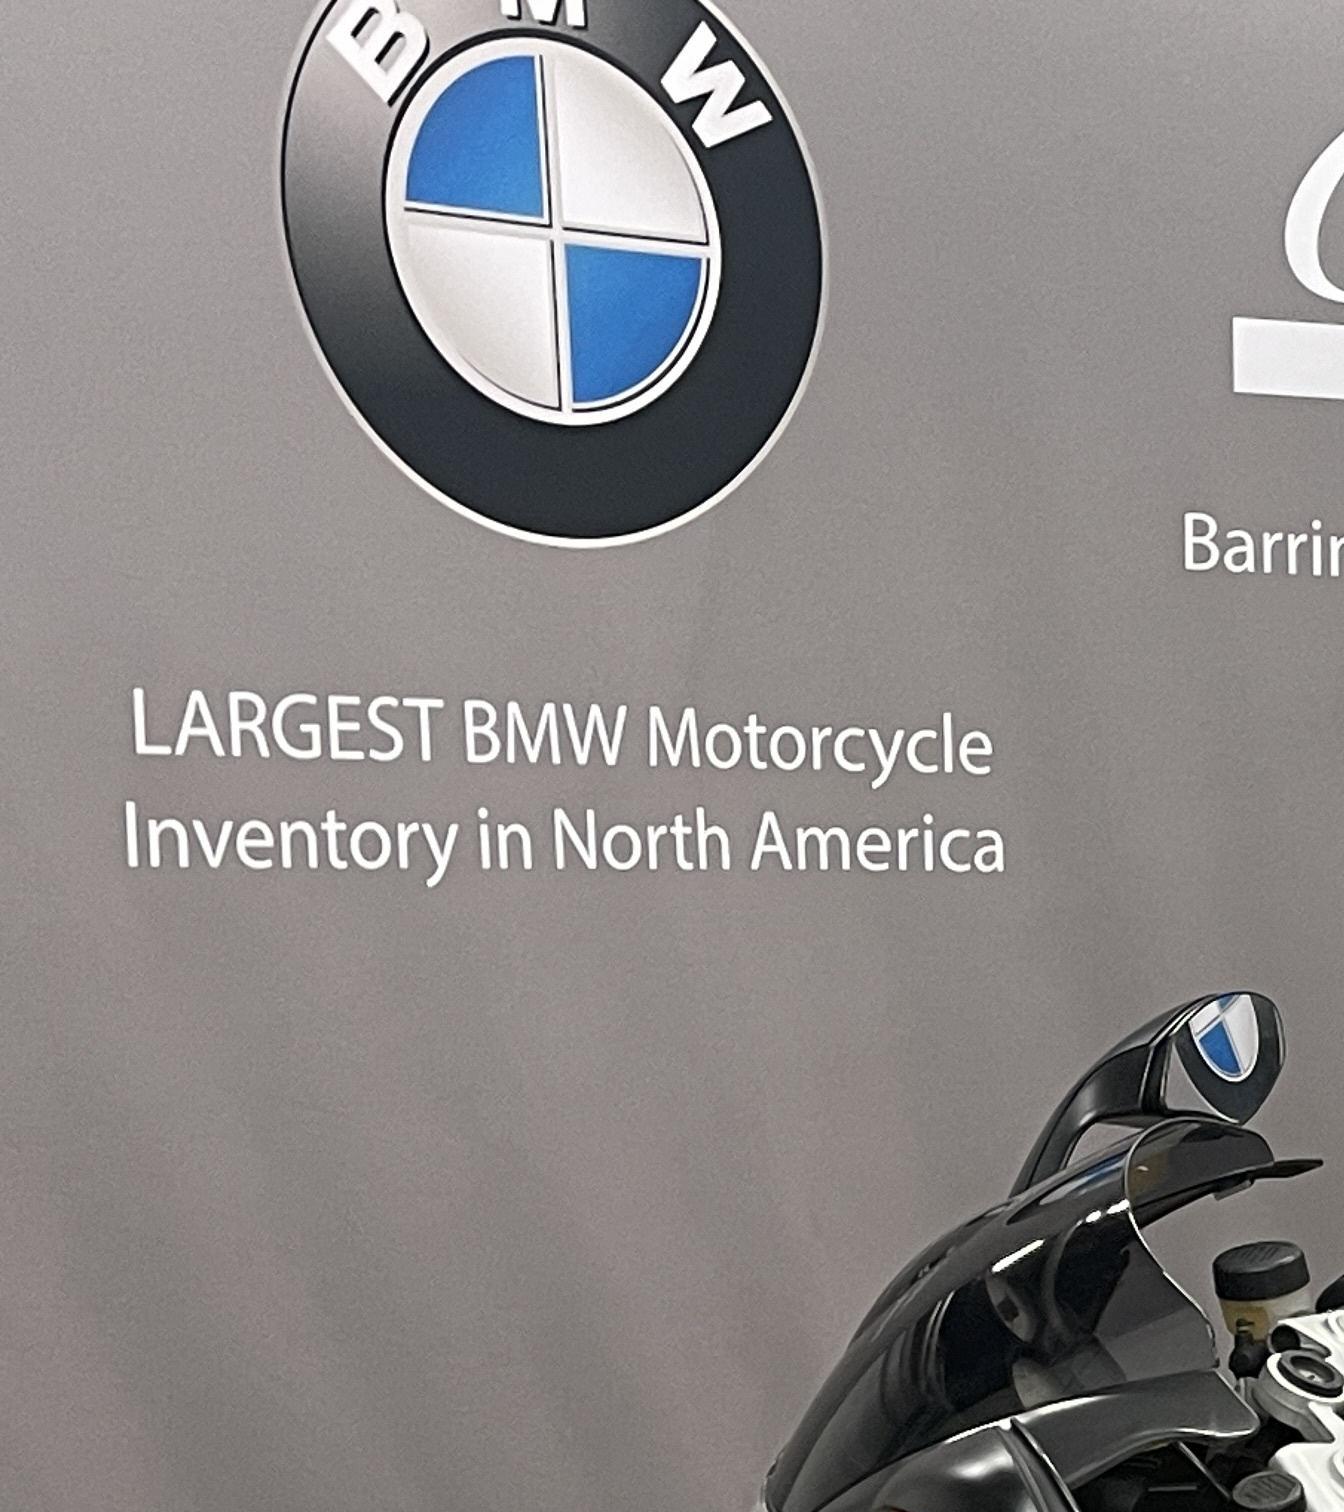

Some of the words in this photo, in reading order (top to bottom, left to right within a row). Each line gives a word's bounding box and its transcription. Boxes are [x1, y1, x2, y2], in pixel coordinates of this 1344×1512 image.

[132, 687, 445, 762] LARGEST
[464, 699, 628, 766] BMW
[649, 706, 993, 790] Motorcycle
[124, 800, 459, 888] Inventory
[477, 806, 533, 870] in
[553, 806, 731, 871] North
[750, 811, 1005, 873] America
